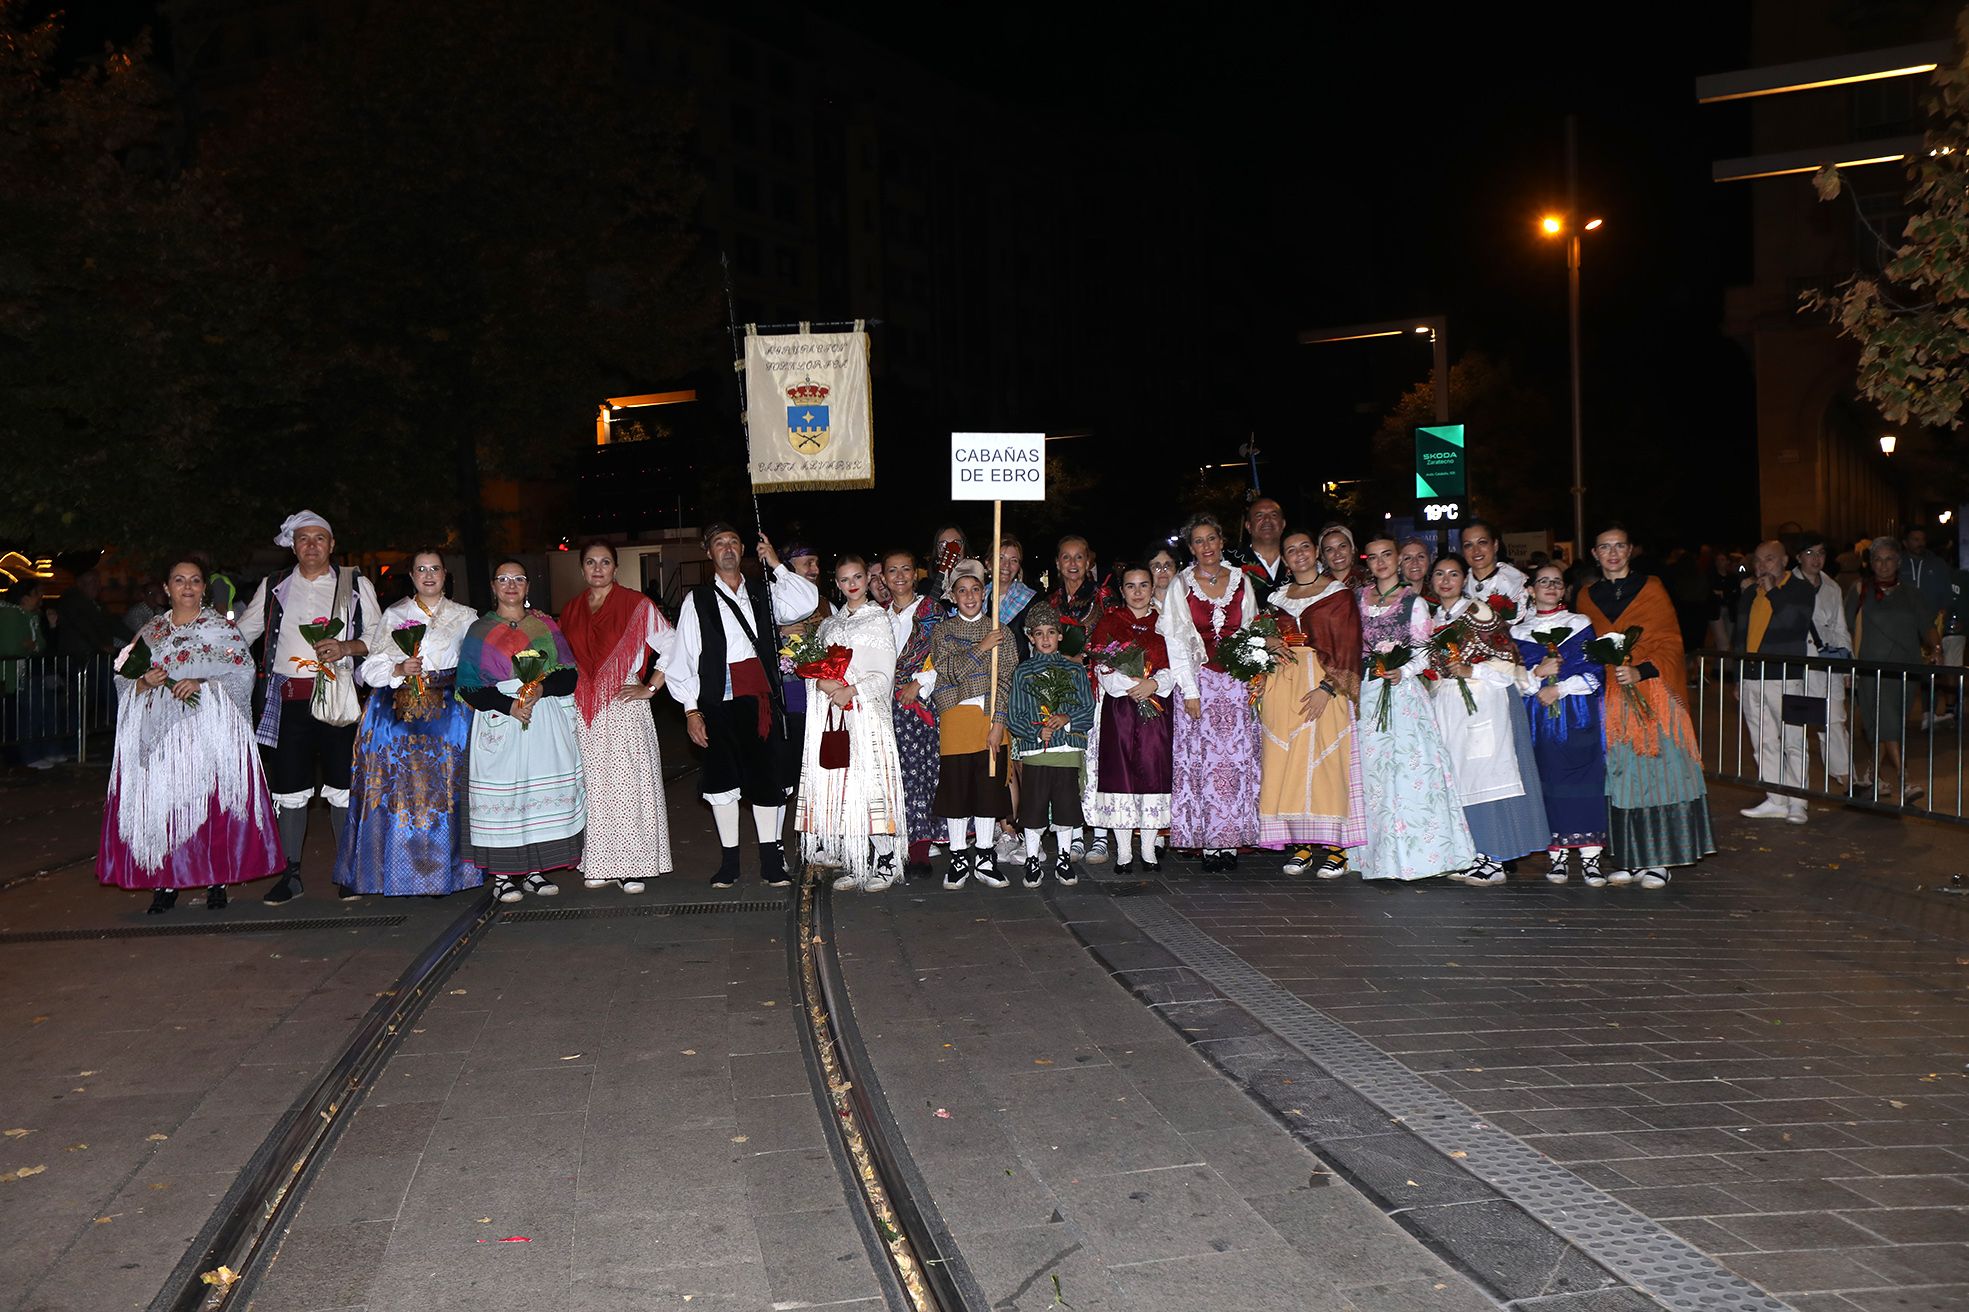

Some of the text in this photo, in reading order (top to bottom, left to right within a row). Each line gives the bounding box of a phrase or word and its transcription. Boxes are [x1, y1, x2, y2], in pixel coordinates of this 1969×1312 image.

[955, 446, 1039, 462] CABAÑAS
[961, 468, 1039, 482] DE EBRO
